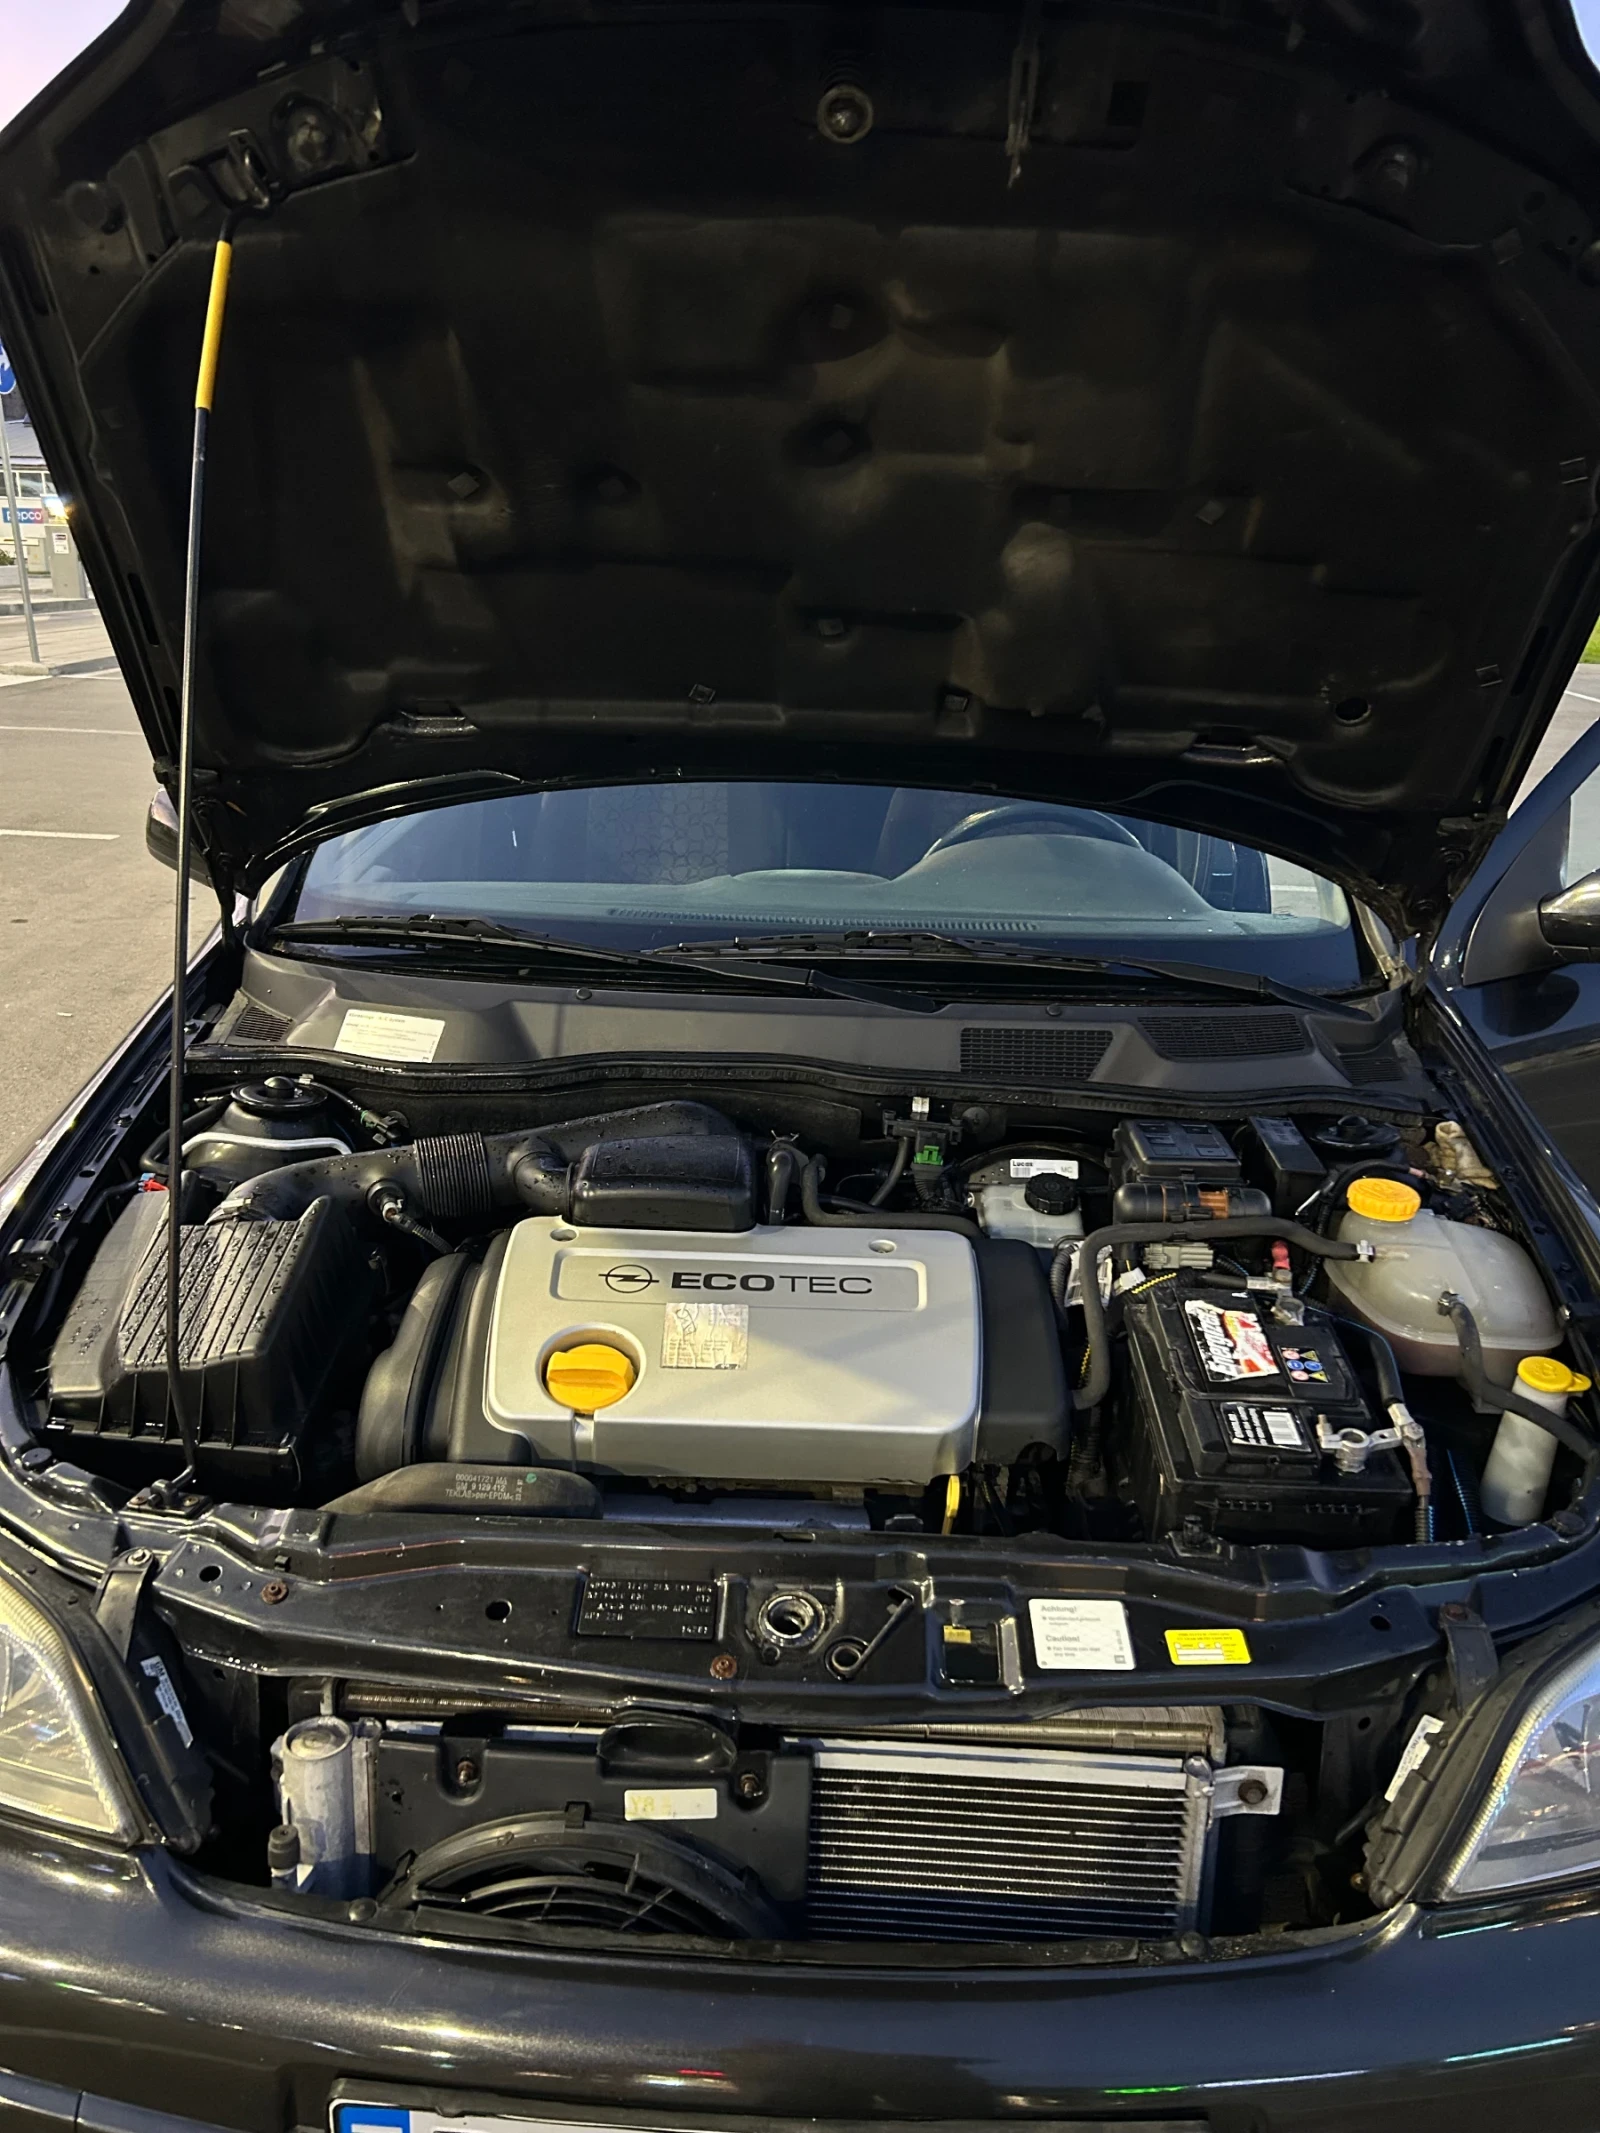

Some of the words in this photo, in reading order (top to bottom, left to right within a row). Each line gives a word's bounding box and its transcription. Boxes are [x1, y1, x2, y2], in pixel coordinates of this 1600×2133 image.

[671, 1271, 873, 1295] ECOTEC
[1041, 1605, 1077, 1613] Achtung!
[1045, 1635, 1080, 1643] Caution!
